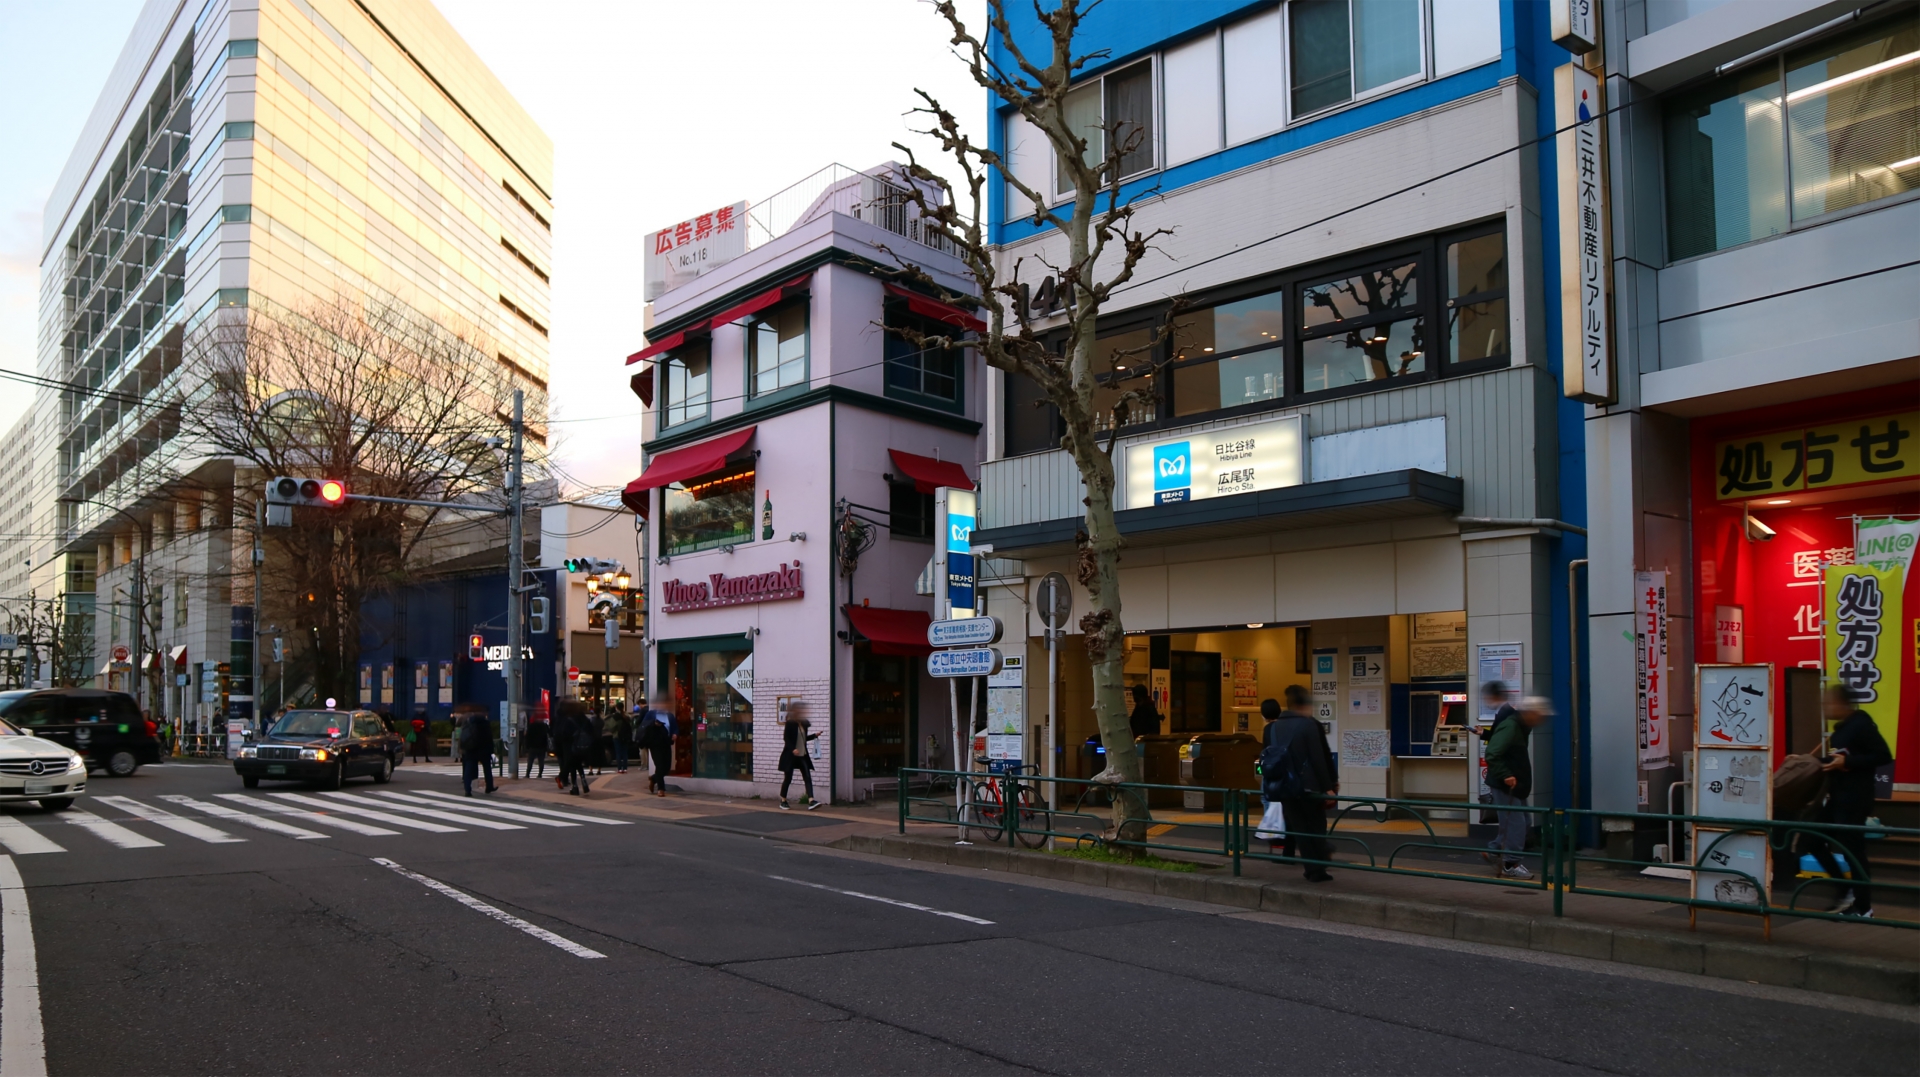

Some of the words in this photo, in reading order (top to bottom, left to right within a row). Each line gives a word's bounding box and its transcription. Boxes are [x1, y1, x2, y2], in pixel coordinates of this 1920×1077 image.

[655, 205, 735, 255] 広告募集
[1580, 129, 1602, 377] 三井不動産リアルティ
[1215, 438, 1256, 456] 日比谷線
[1219, 454, 1239, 462] Hibiya
[1239, 451, 1253, 459] Line
[1719, 419, 1910, 496] 処方せ
[1217, 467, 1255, 486] 広尾駅
[1161, 490, 1184, 499] 東京メトロ
[1217, 485, 1239, 494] Hiro-o
[1241, 482, 1256, 491] Sta.
[1858, 533, 1915, 558] LINE@
[662, 578, 707, 605] Vinos
[709, 559, 801, 599] Yamazaki
[949, 574, 973, 583] 東京メトロ
[1717, 620, 1742, 632] コスモス
[949, 651, 991, 665] 都立中央図書館
[1313, 681, 1337, 691] 広尾駅
[1320, 709, 1330, 717] 03
